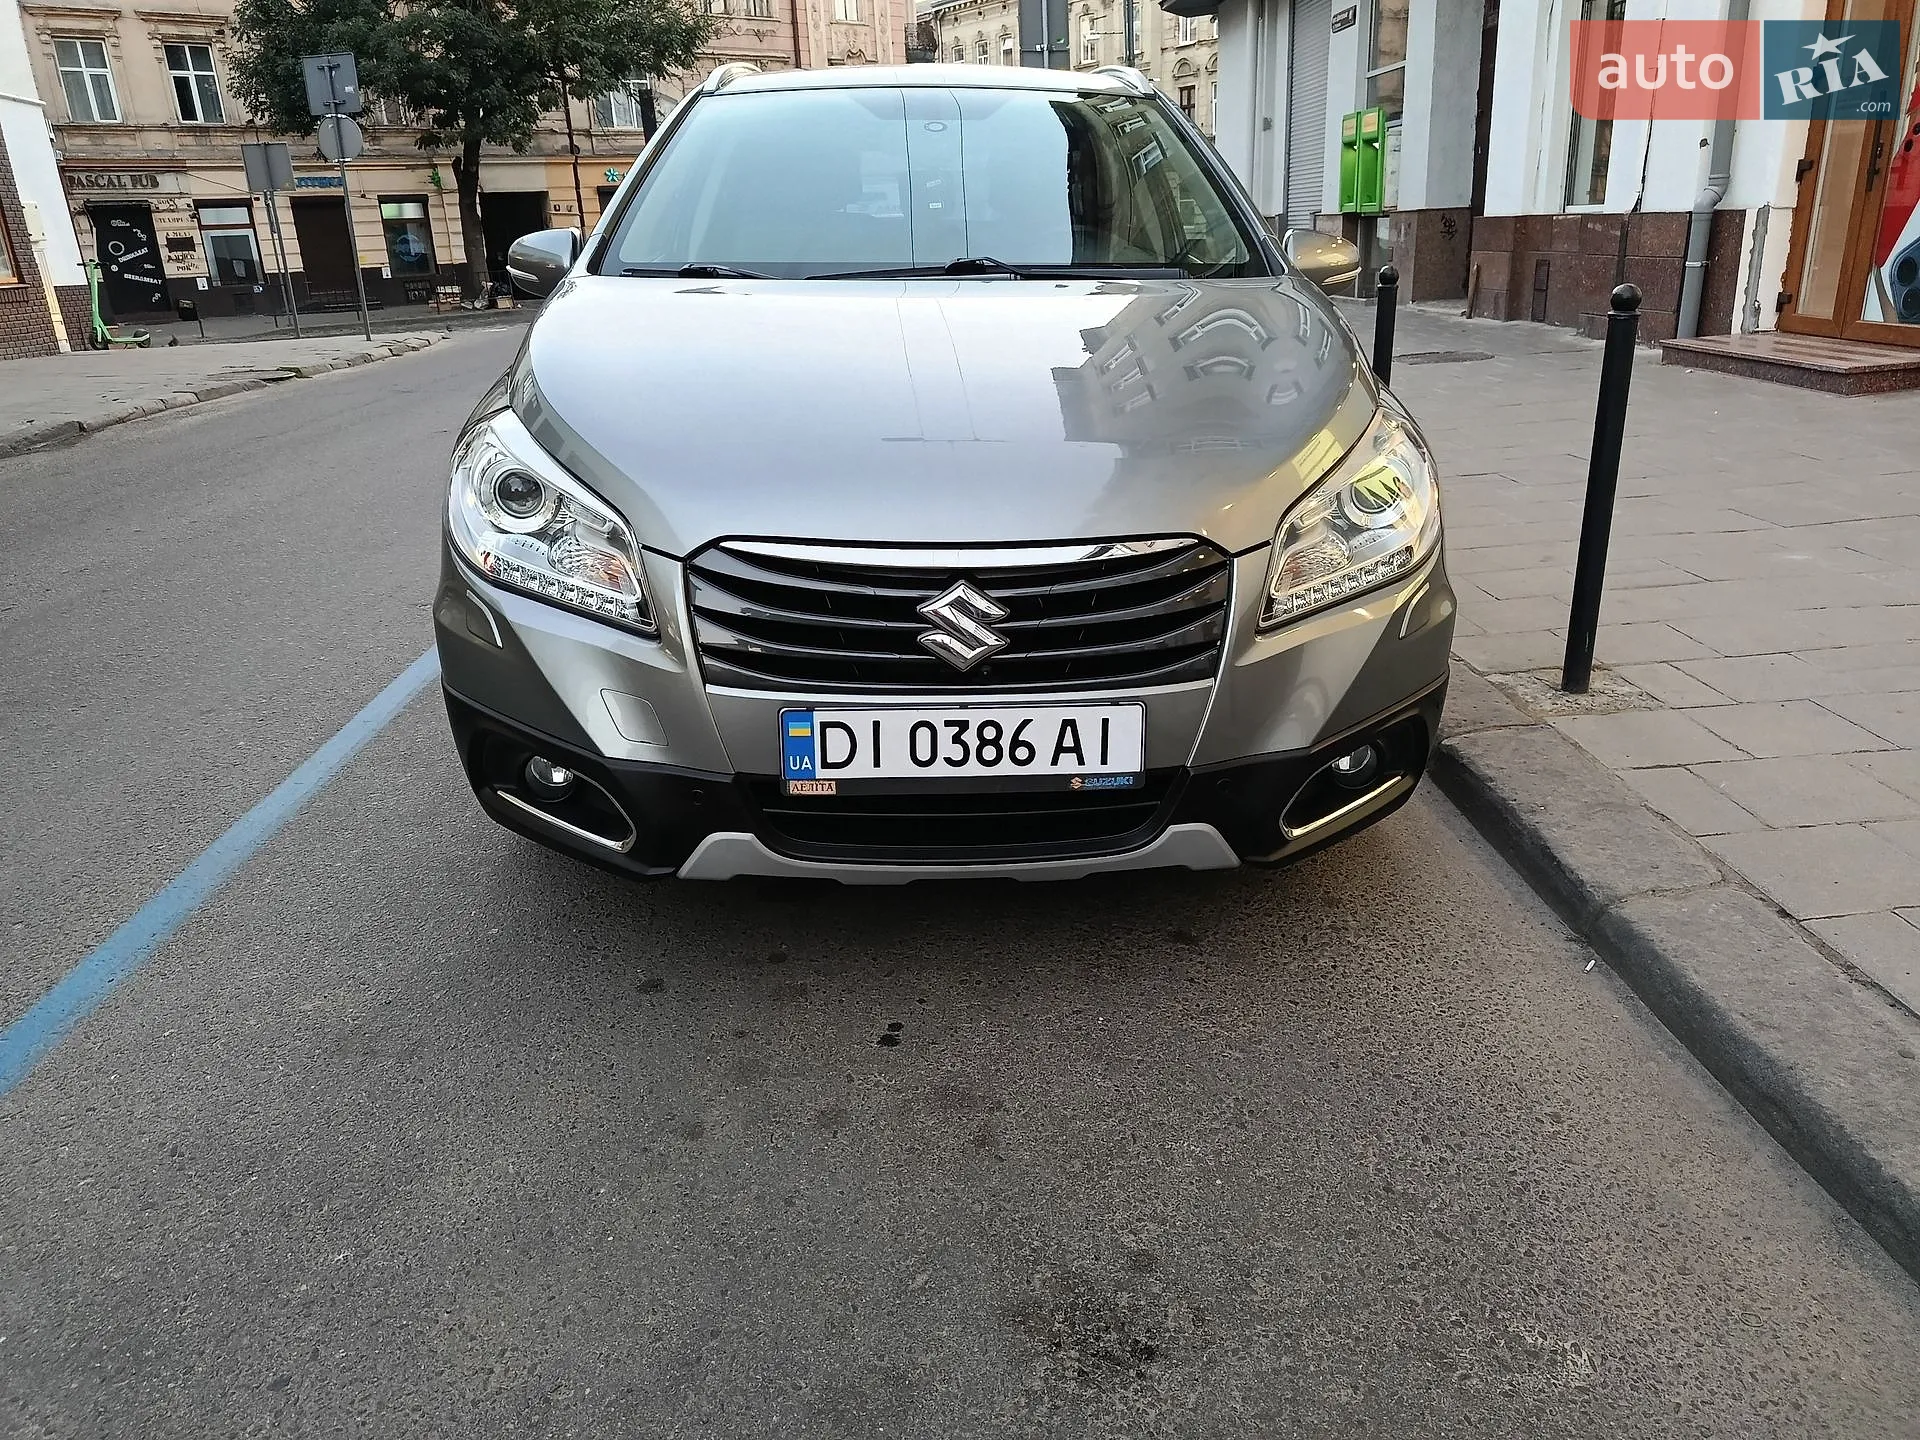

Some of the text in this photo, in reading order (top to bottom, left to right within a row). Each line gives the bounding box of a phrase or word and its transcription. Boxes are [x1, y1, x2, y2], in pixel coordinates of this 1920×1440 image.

[67, 174, 160, 188] PASCAL PUB
[819, 717, 1109, 770] DI 0386 AI
[789, 755, 812, 770] UA
[1084, 776, 1134, 787] SUZUKI
